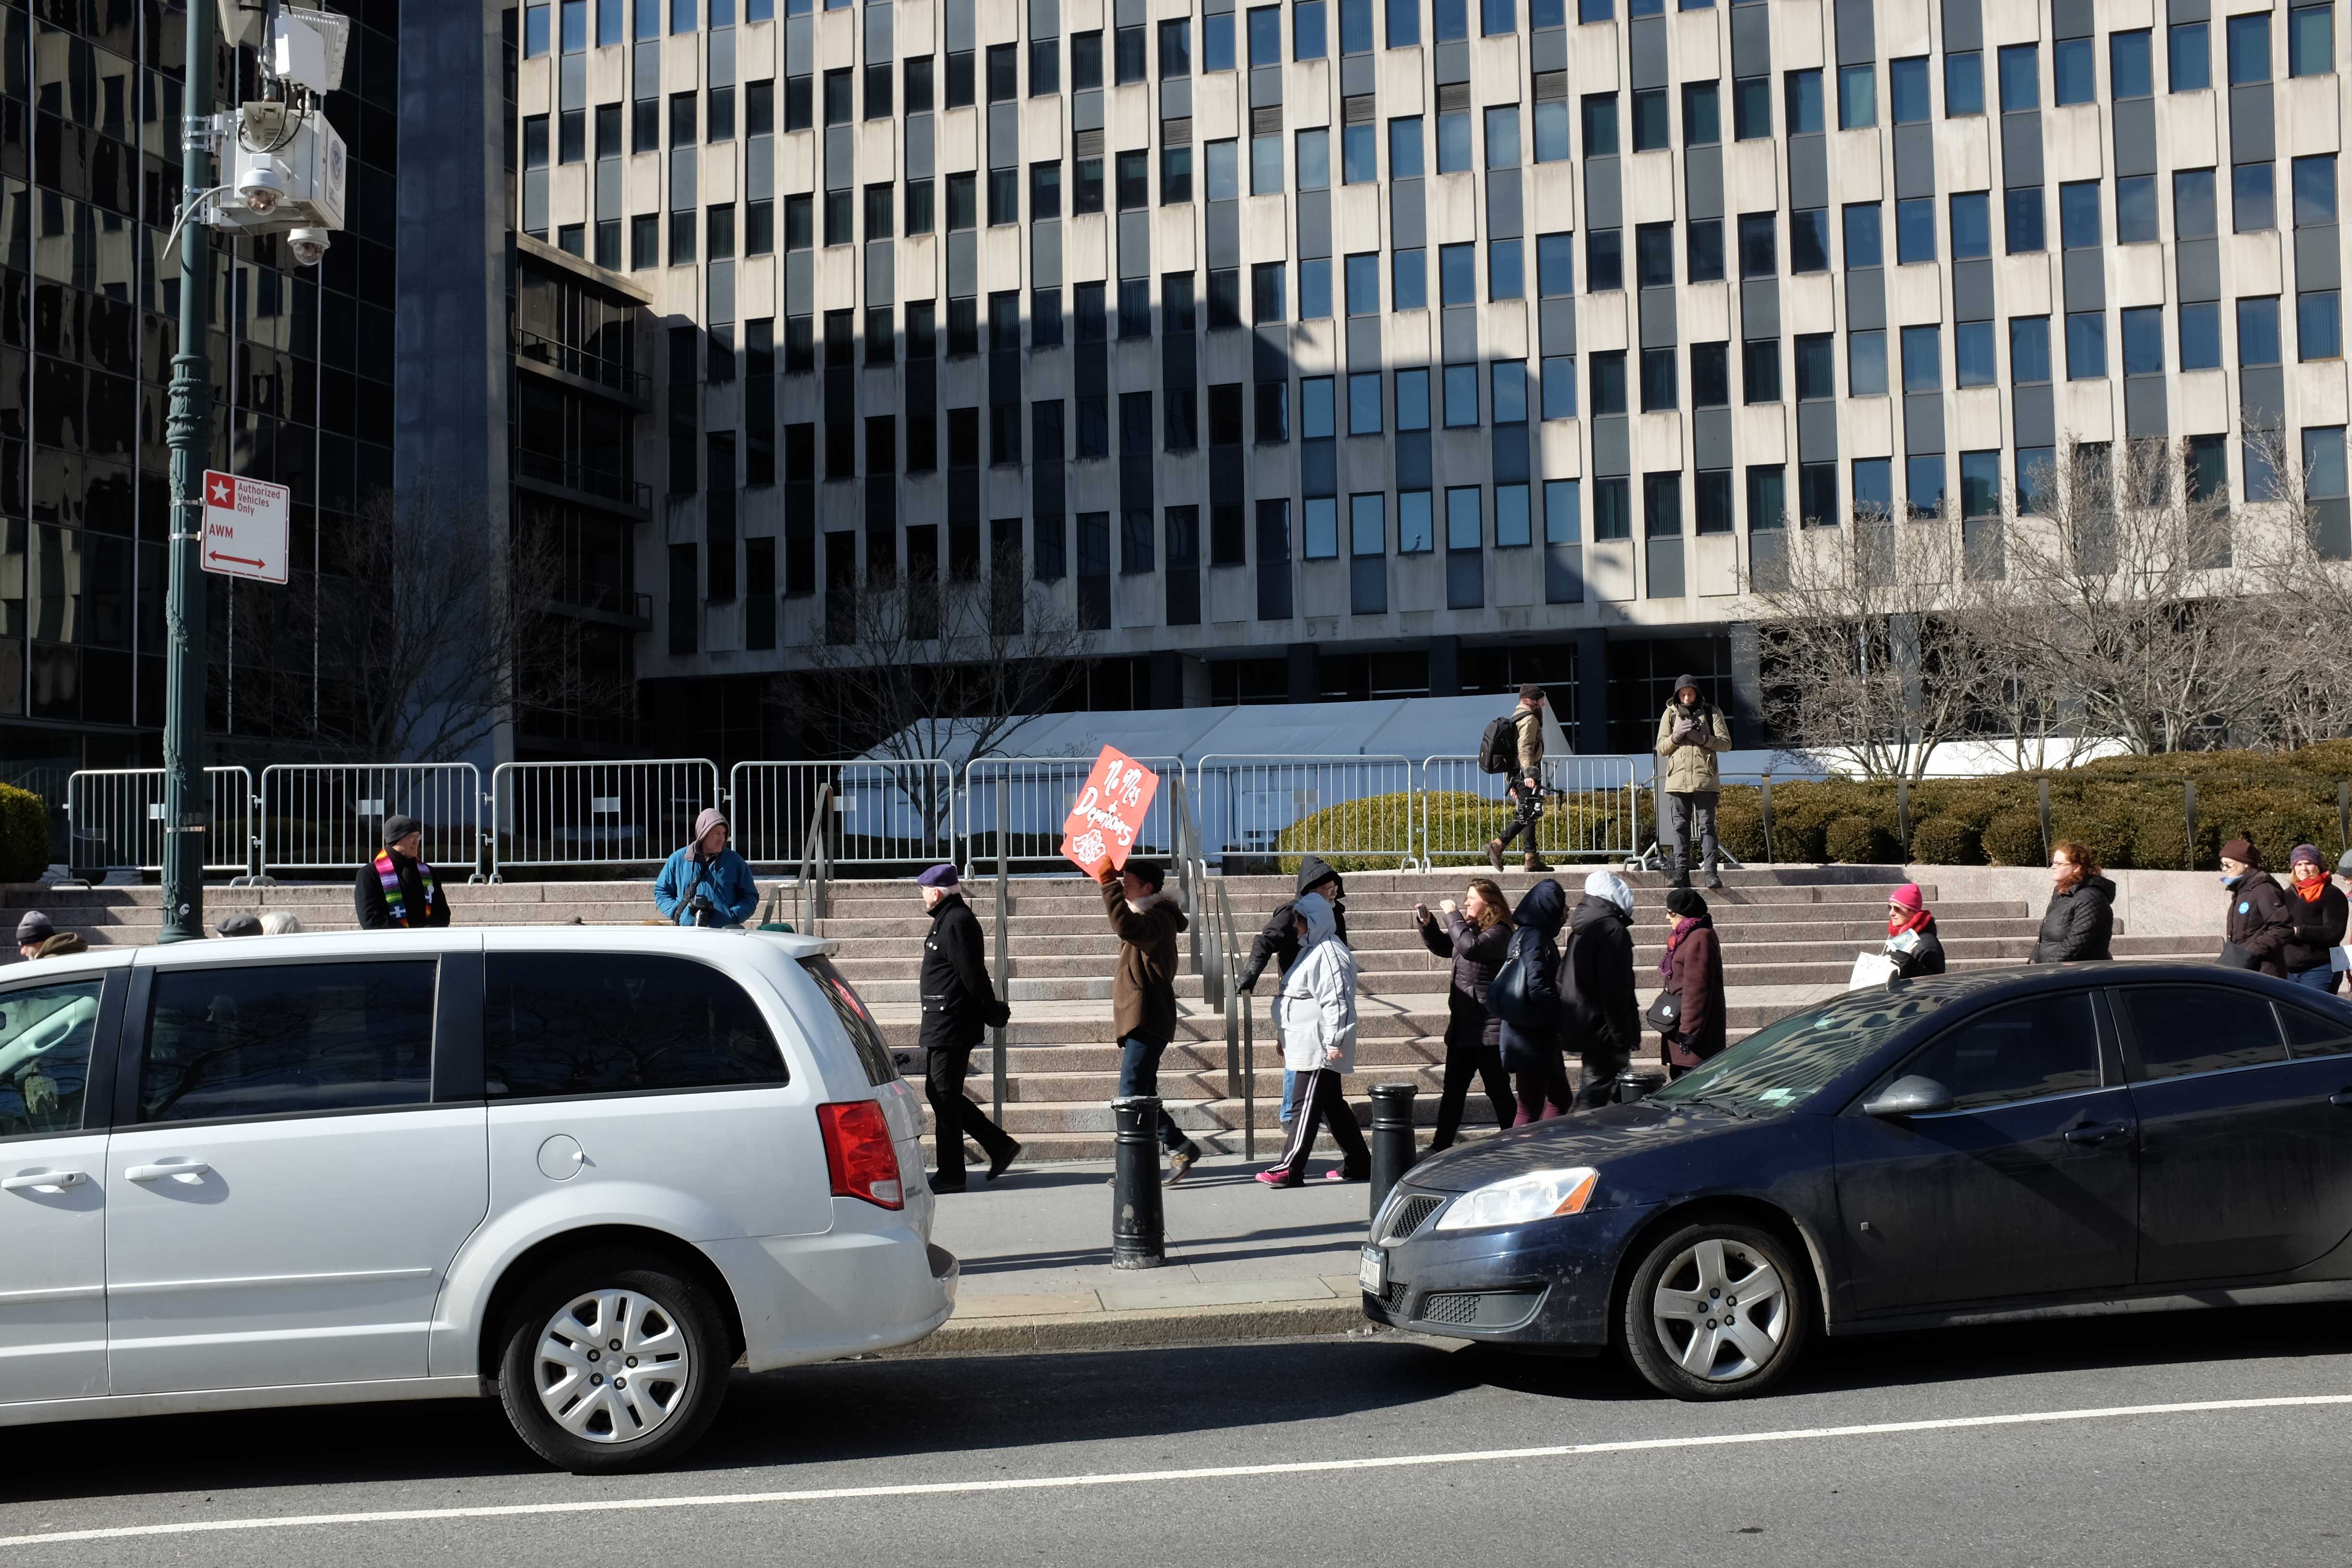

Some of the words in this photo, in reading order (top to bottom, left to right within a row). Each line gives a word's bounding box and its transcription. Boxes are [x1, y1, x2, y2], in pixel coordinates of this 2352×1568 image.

[238, 482, 281, 499] Authorized
[238, 493, 270, 507] Vehicles
[237, 503, 255, 516] Only
[209, 523, 233, 539] AWM
